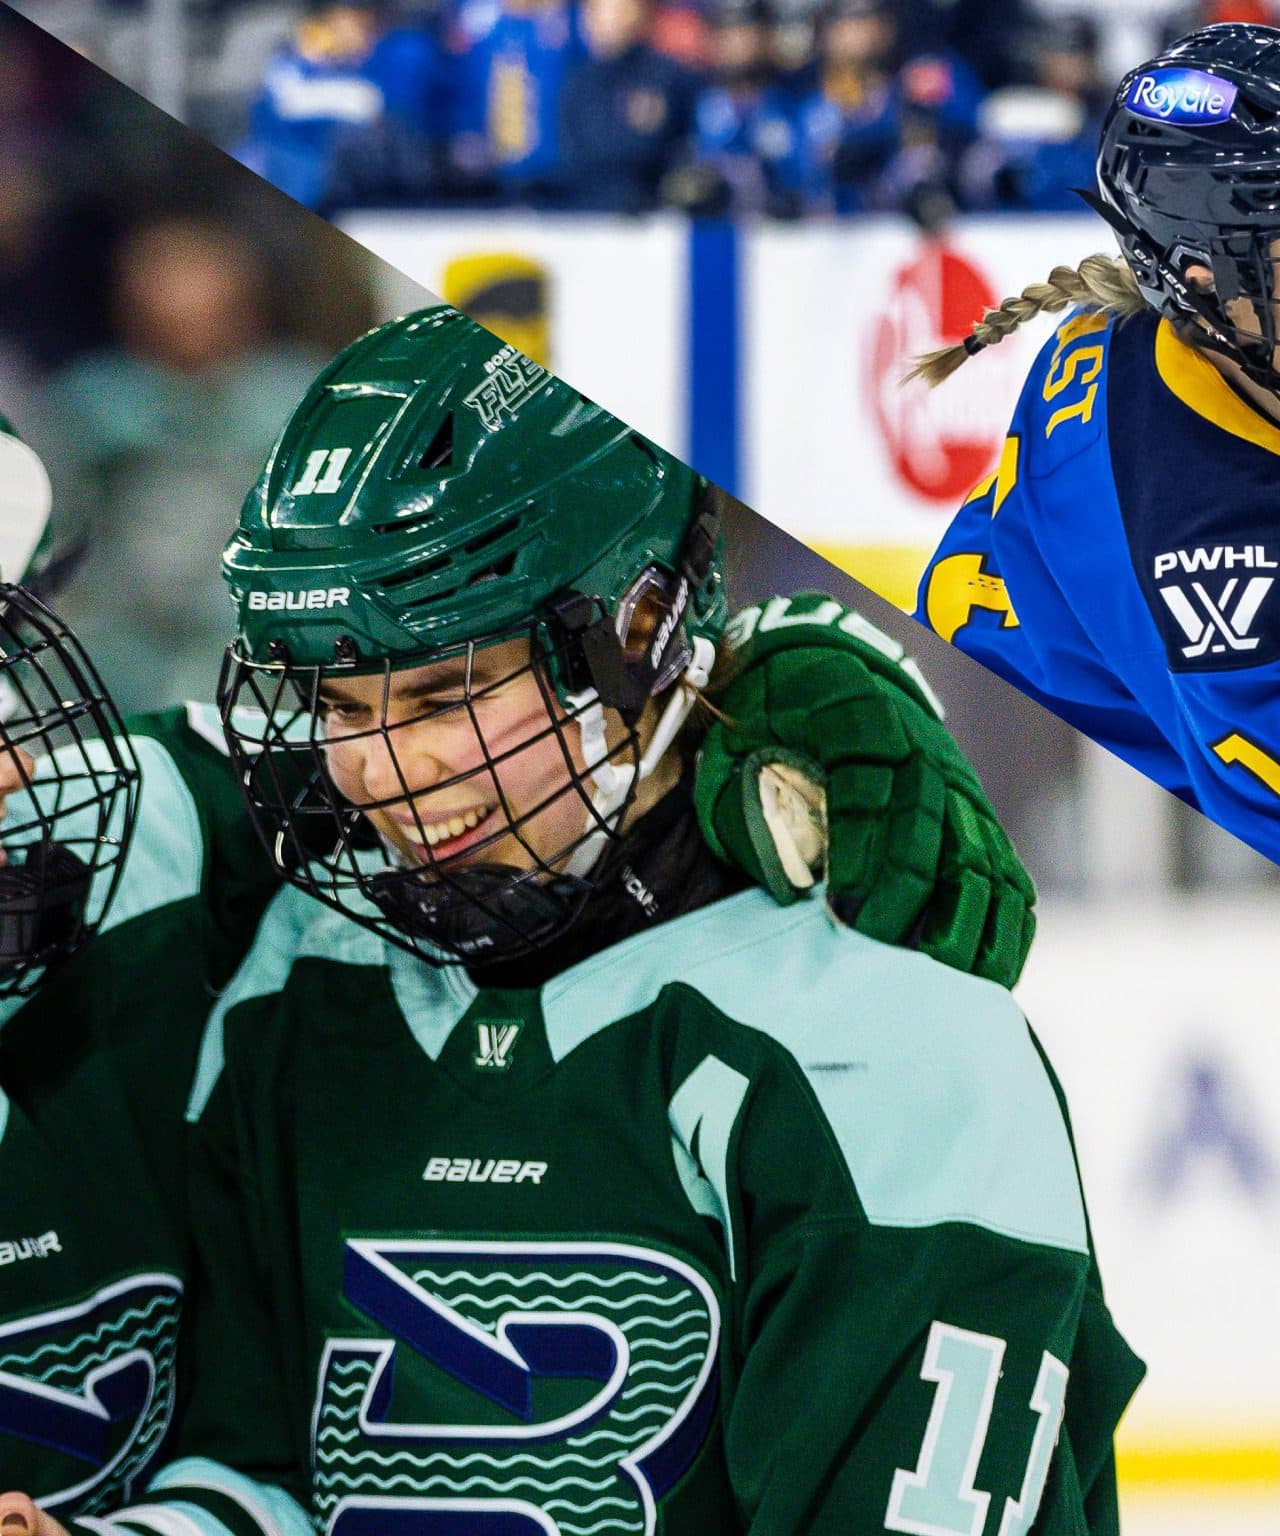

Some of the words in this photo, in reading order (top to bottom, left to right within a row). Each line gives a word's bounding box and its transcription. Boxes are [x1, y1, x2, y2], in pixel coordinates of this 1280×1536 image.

[1133, 76, 1224, 117] Royale
[291, 448, 352, 495] 11
[1154, 545, 1278, 580] PWHL
[248, 587, 350, 610] BAUER
[422, 1157, 548, 1184] BAUER
[884, 1320, 1070, 1536] 11
